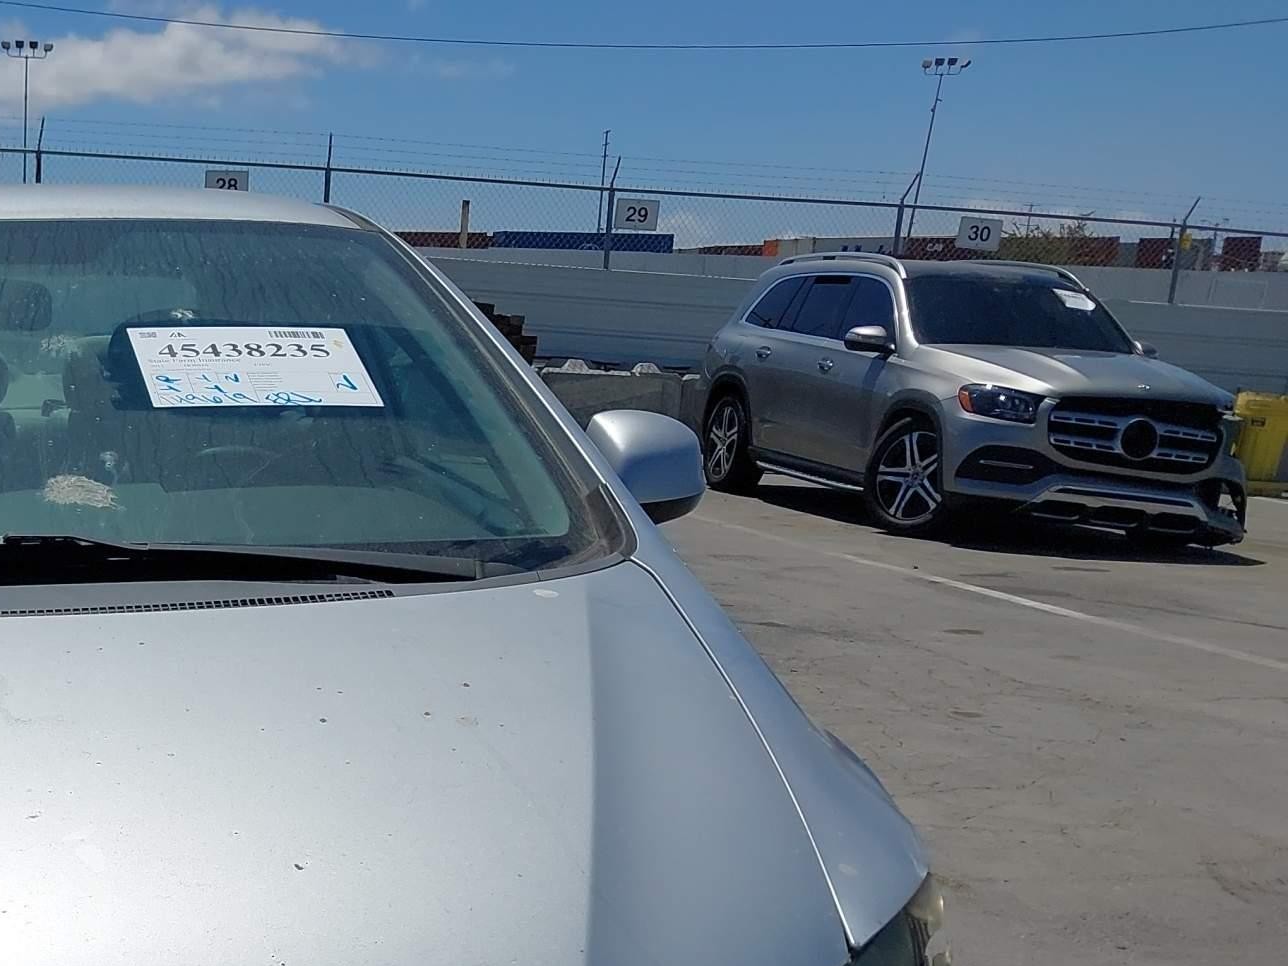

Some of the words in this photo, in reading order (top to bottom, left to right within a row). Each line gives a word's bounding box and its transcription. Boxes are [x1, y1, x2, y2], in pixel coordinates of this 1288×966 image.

[625, 206, 649, 223] 29
[967, 225, 991, 242] 30
[158, 343, 330, 358] 45438235
